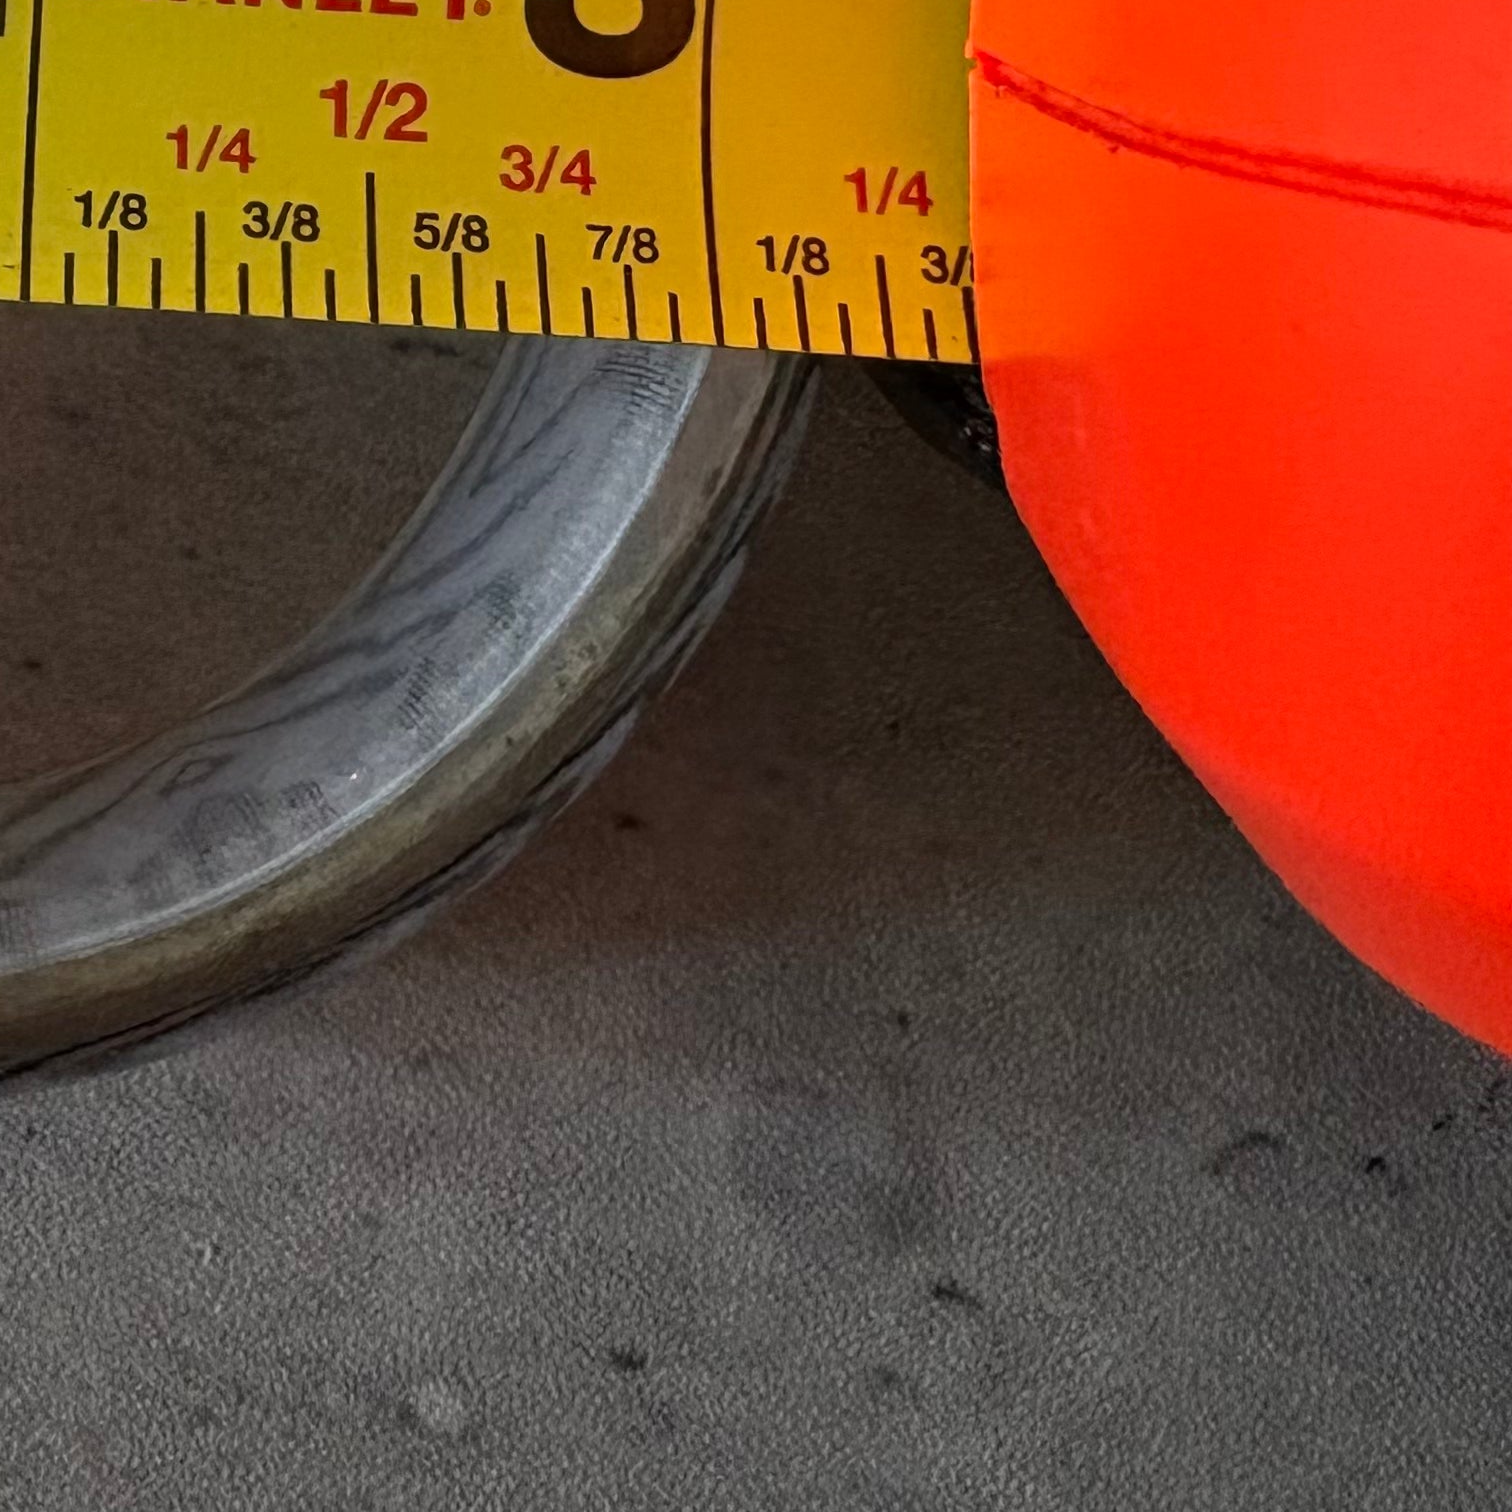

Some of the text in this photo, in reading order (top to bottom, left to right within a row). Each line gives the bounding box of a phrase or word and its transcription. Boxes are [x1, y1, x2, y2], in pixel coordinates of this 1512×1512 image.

[320, 78, 428, 144] 1/2
[167, 125, 256, 173] 1/4
[499, 145, 597, 196] 3/4
[844, 166, 933, 216] 1/4
[74, 190, 148, 231] 1/8
[242, 202, 320, 242] 3/8
[414, 212, 489, 253] 5/8
[586, 224, 660, 265] 7/8
[756, 236, 830, 276] 1/8
[920, 245, 974, 286] 3/
